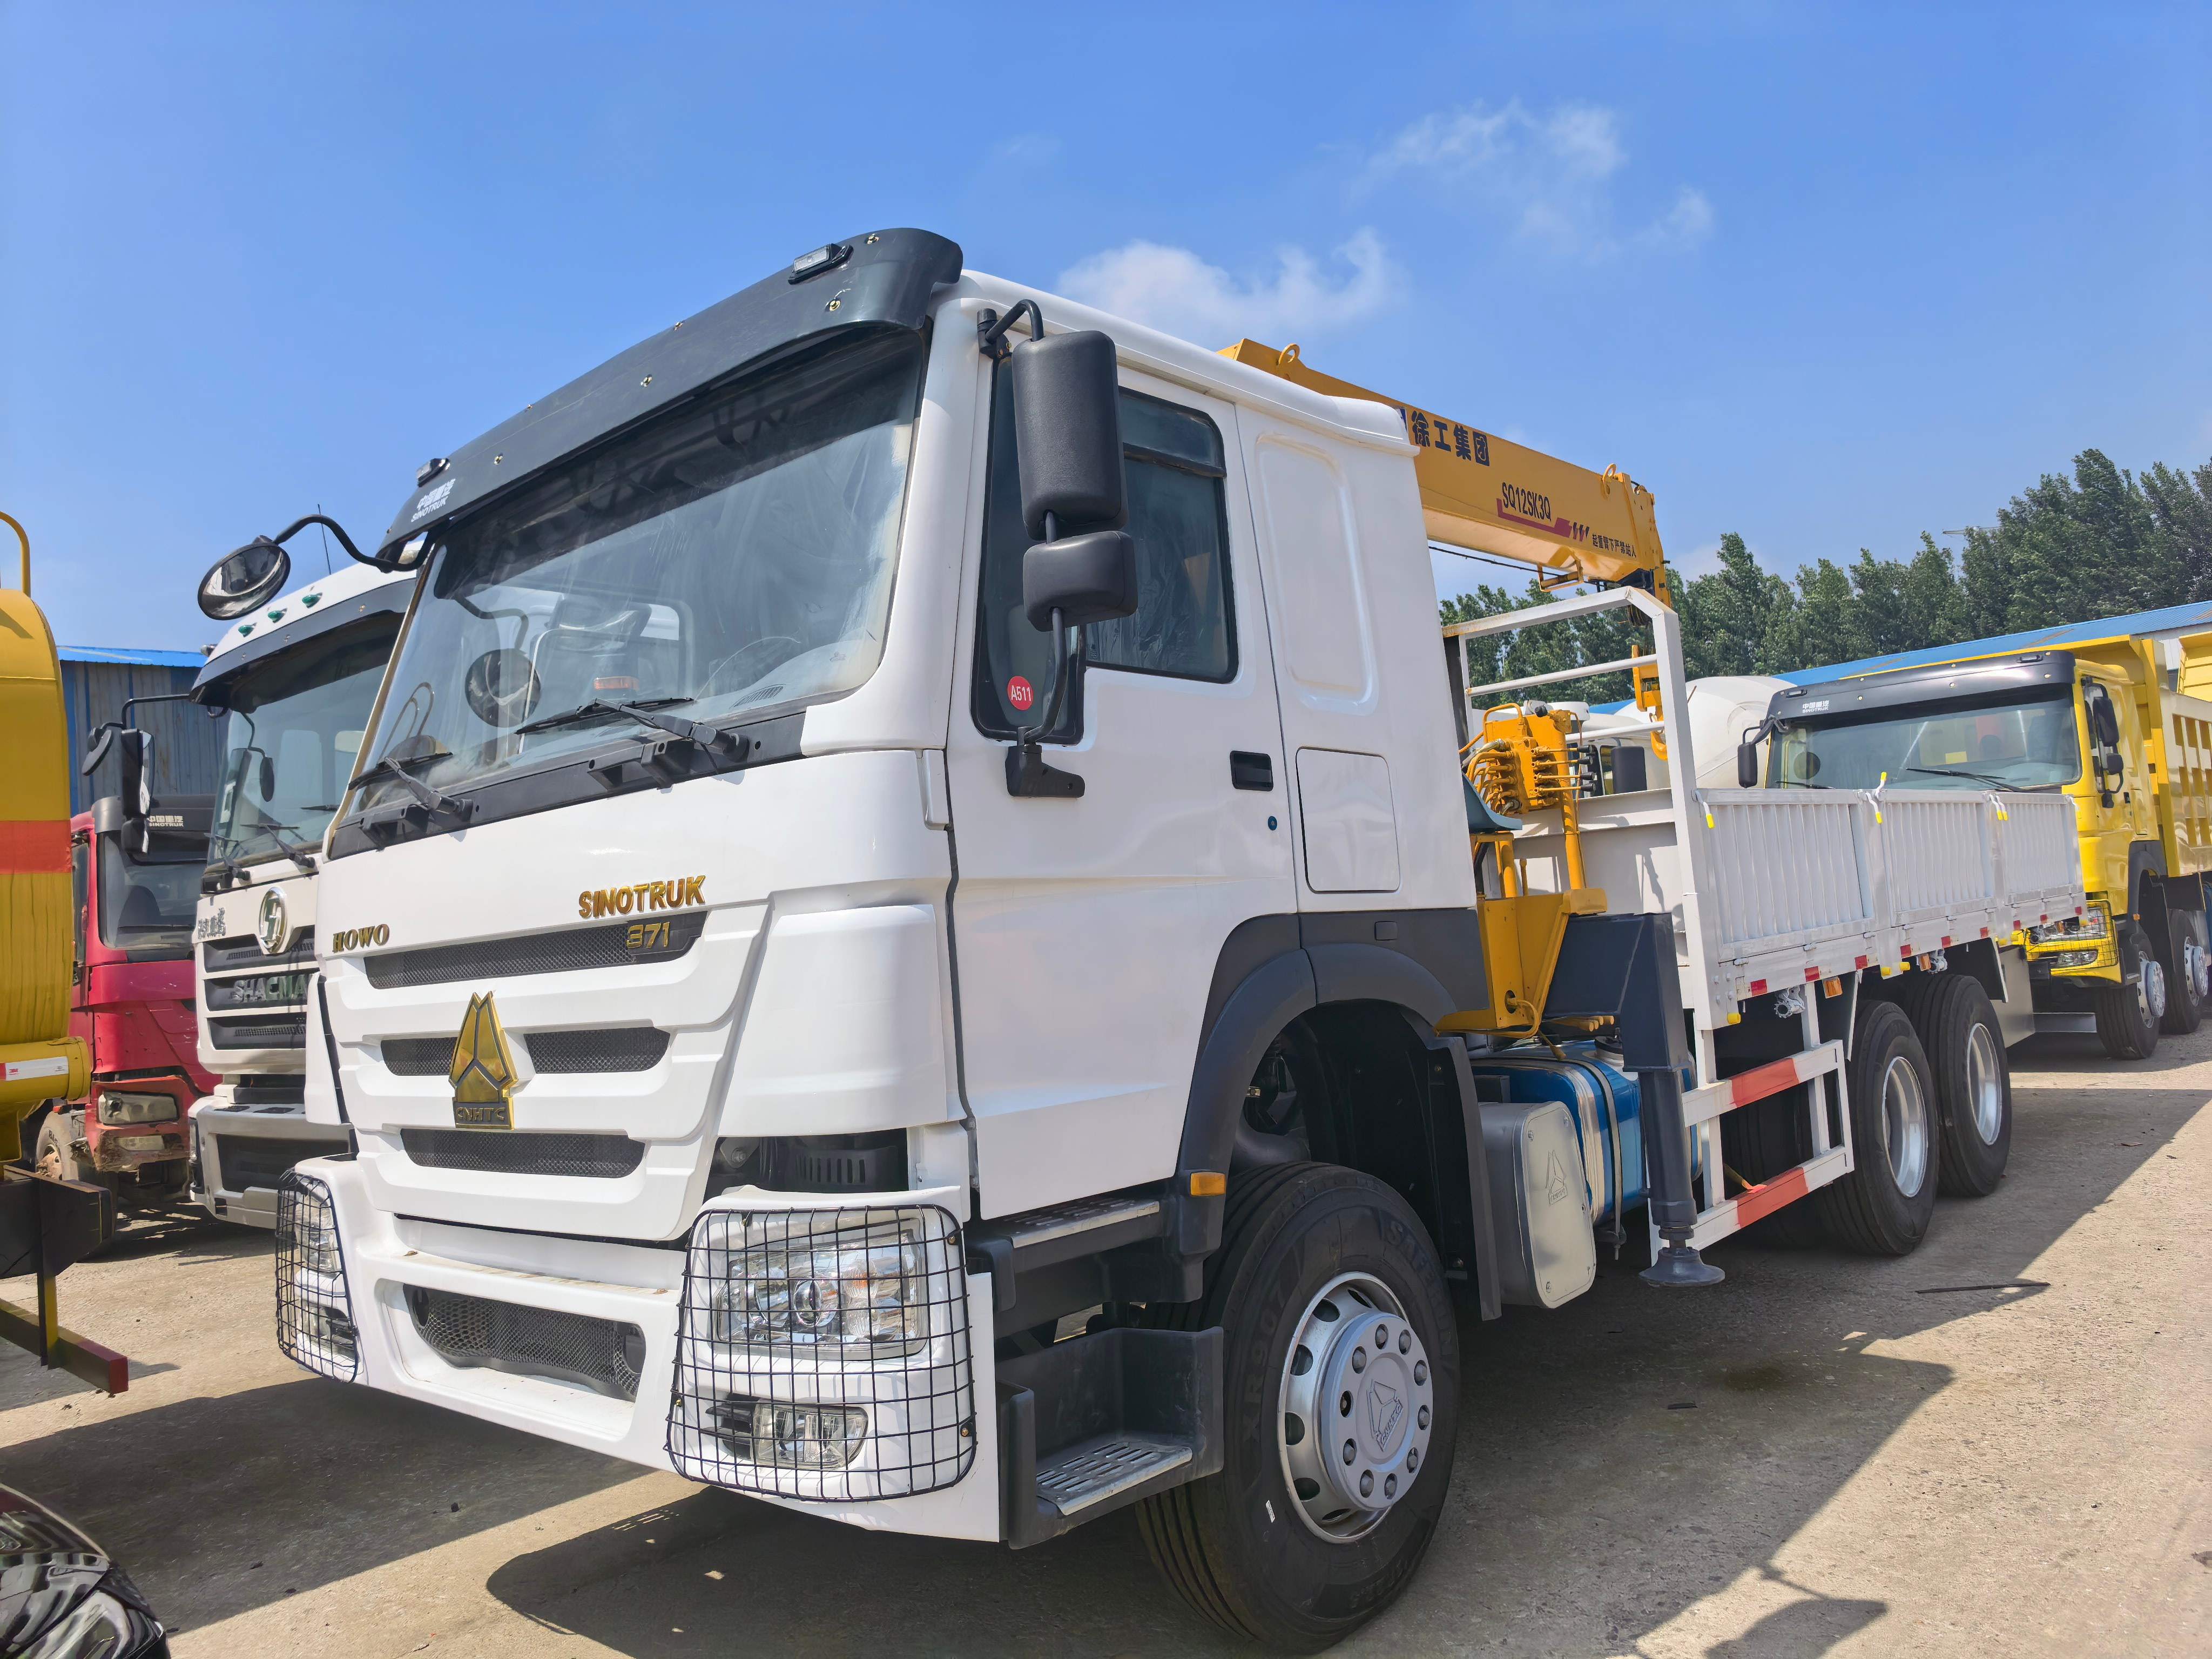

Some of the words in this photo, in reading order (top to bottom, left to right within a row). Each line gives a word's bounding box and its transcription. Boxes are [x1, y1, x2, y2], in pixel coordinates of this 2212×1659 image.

[1412, 410, 1490, 467] 徐工集团
[1502, 482, 1552, 522] SQ12SK3Q
[1592, 533, 1637, 558] 起重臂下严禁站人
[1010, 685, 1032, 702] A511
[1802, 705, 1829, 713] SINOTRUK
[578, 875, 706, 919] SINOTRUK
[332, 923, 390, 953] HOWO
[626, 921, 671, 949] 371
[232, 974, 307, 1003] SHACMA
[456, 1107, 505, 1121] CNHTC
